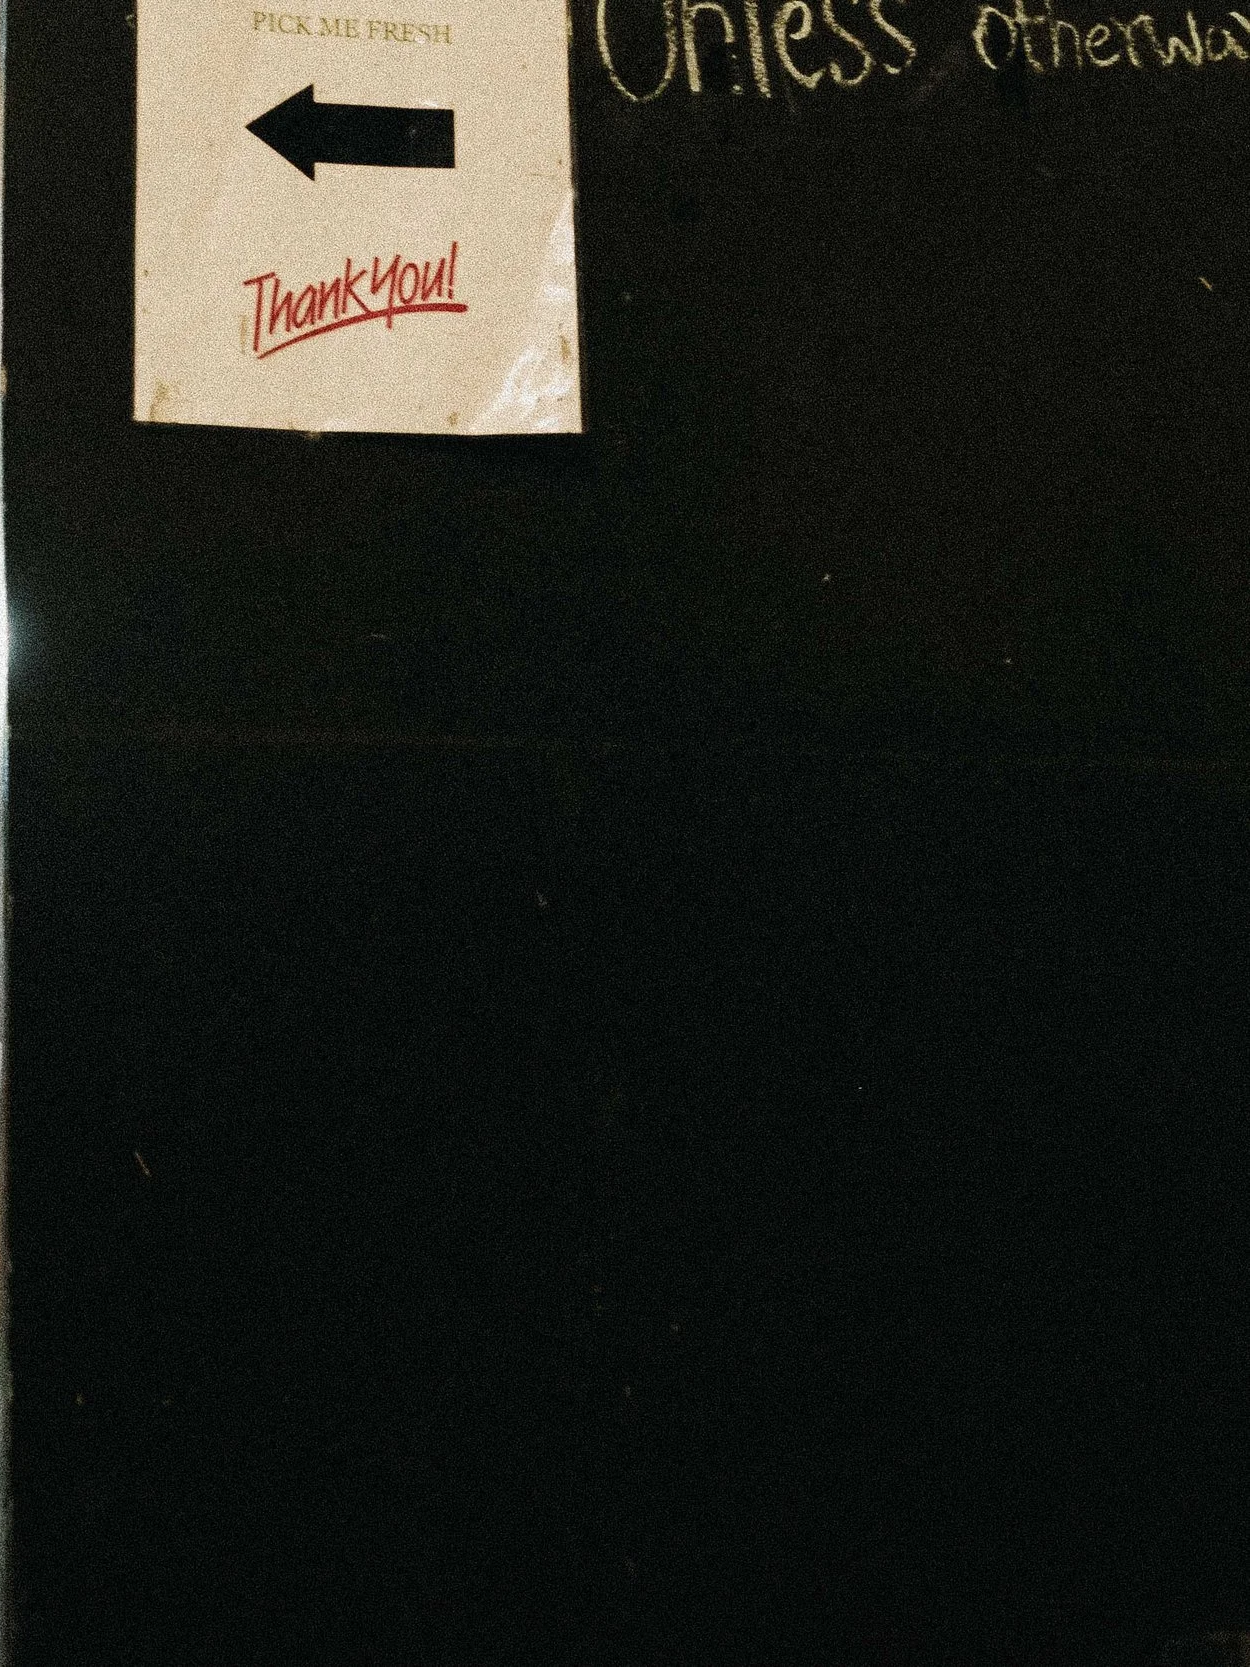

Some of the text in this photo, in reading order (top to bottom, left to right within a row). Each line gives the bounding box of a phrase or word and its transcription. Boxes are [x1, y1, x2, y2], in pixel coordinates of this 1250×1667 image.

[253, 11, 452, 43] PICK ME FRESH
[597, 0, 916, 101] Unless
[243, 257, 372, 352] Thank
